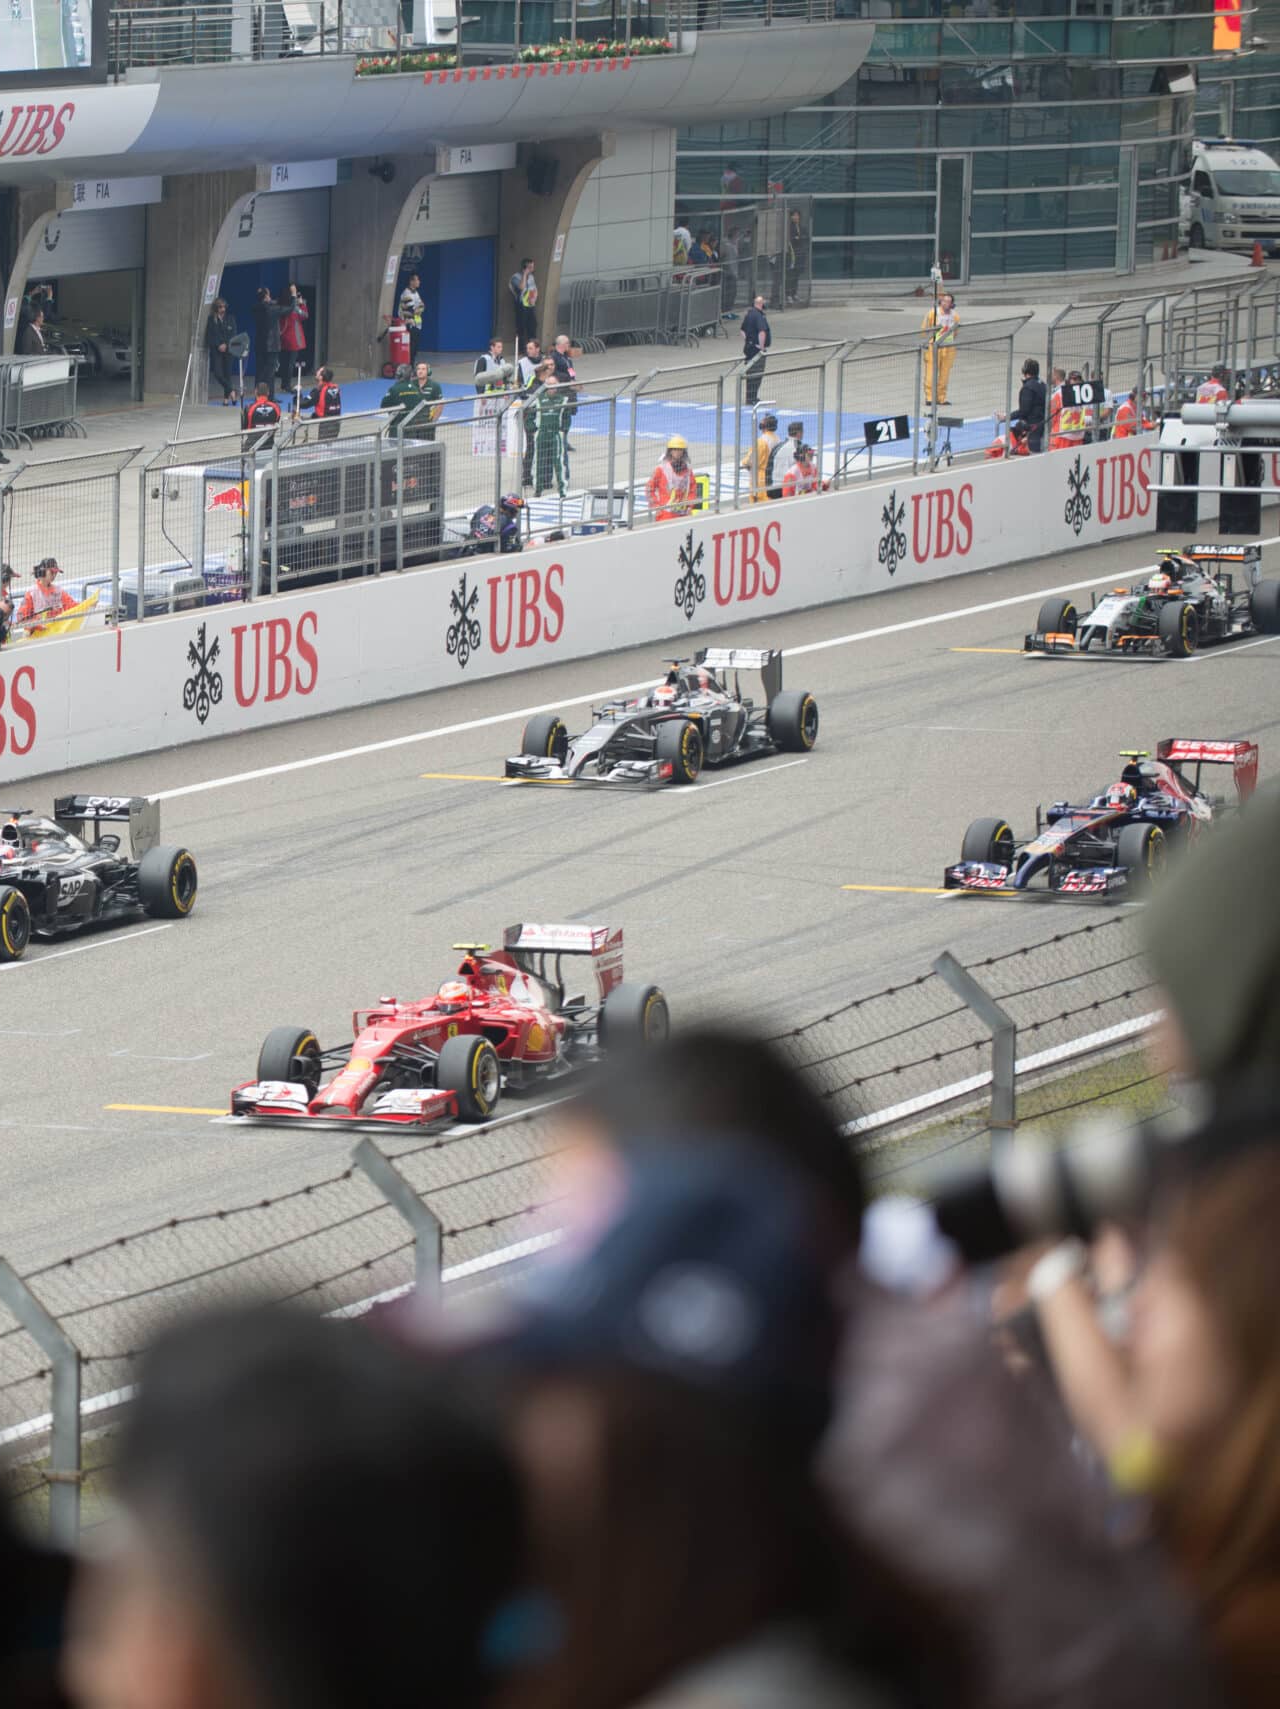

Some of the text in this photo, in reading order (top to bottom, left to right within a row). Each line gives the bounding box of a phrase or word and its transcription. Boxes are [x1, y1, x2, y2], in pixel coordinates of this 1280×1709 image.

[460, 150, 472, 165] FIA
[275, 165, 289, 182] FIA
[96, 182, 110, 199] FIA
[1072, 384, 1094, 404] 10
[876, 419, 897, 442] 21
[1096, 448, 1152, 525] UBS
[911, 483, 973, 564] UBS
[712, 520, 782, 606] UBS
[486, 563, 564, 654] UBS
[230, 610, 319, 708] UBS
[60, 880, 82, 897] SAP
